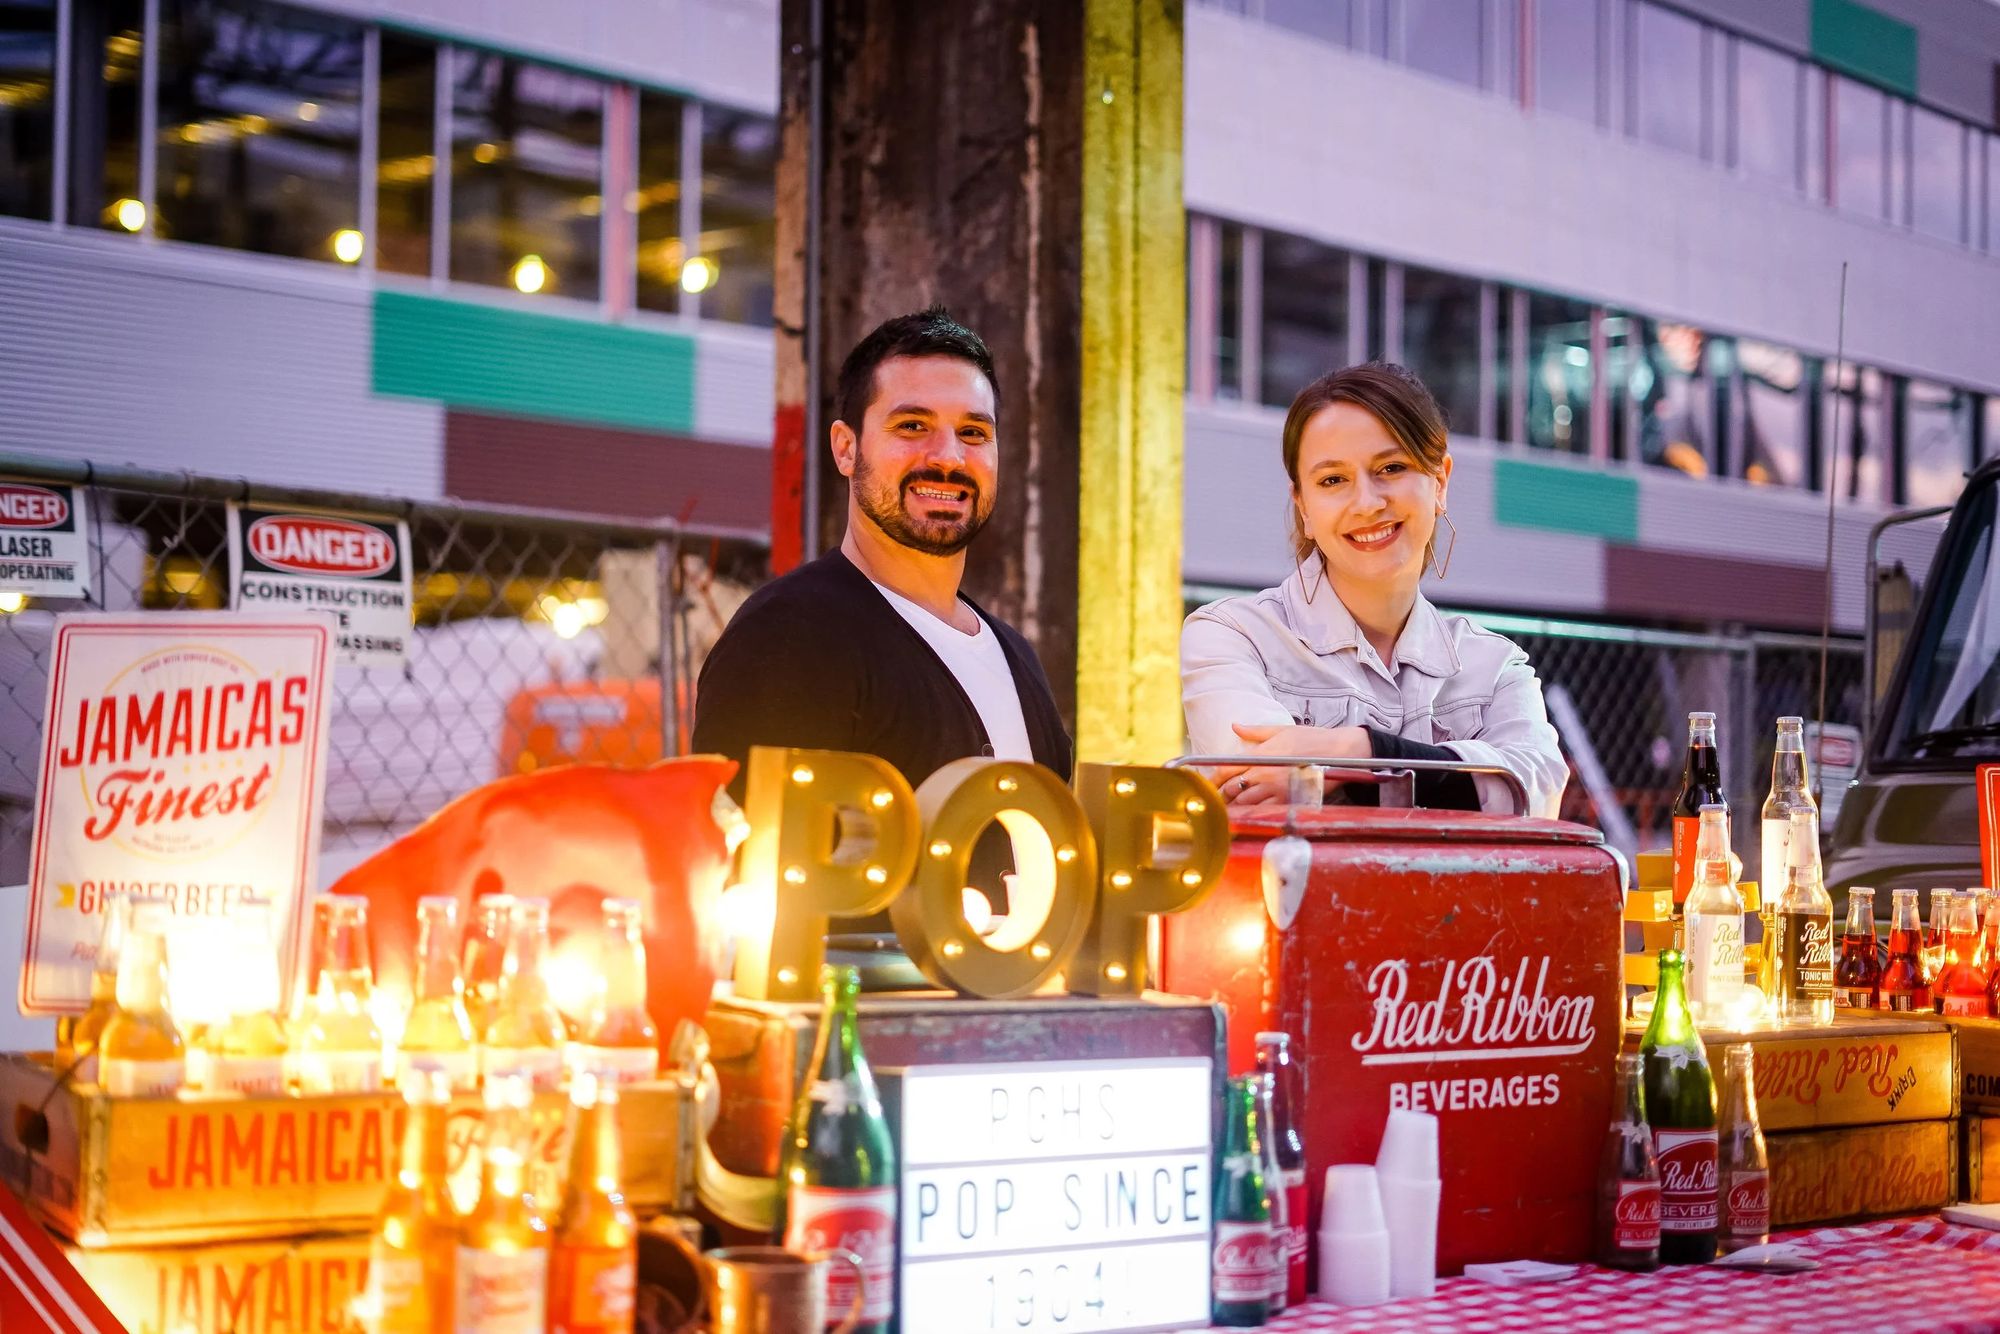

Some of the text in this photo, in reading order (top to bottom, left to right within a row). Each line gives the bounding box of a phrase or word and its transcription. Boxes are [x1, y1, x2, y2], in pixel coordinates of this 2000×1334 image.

[0, 536, 52, 557] LASER
[258, 524, 386, 567] DANGER
[0, 565, 75, 580] OPERATING
[241, 582, 404, 607] CONSTRUCTION
[337, 635, 402, 651] ASSING
[84, 763, 271, 842] Finest
[735, 745, 1230, 1000] POP
[1713, 922, 1743, 943] Red
[1800, 921, 1830, 942] Red
[1800, 971, 1821, 981] TONIC
[1351, 955, 1596, 1051] Red Ribbon
[1834, 1043, 1898, 1097] Red
[1887, 1066, 1917, 1112] DRINK
[1389, 1074, 1560, 1112] BEVERAGES
[991, 1083, 1115, 1144] PGHS
[1662, 1160, 1699, 1190] Red
[1842, 1151, 1946, 1212] Ribbon
[917, 1165, 1200, 1243] POP SINCE
[1733, 1190, 1760, 1209] Red
